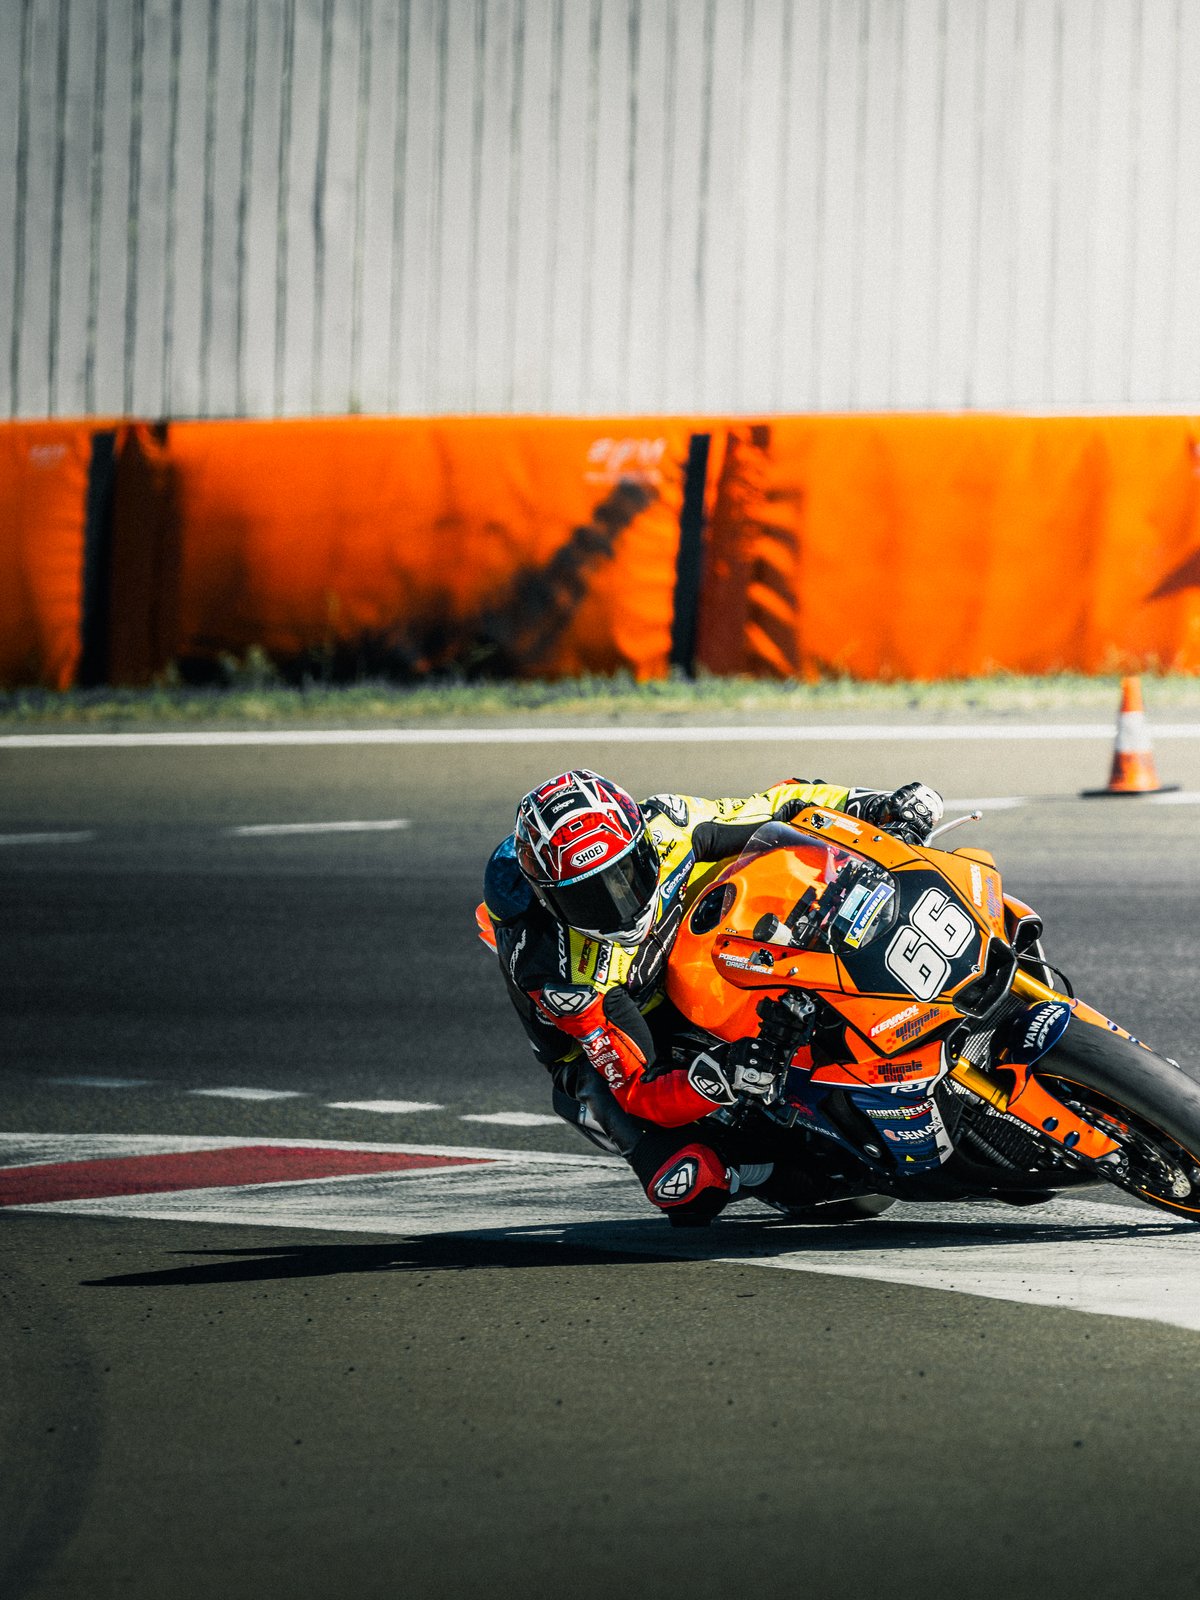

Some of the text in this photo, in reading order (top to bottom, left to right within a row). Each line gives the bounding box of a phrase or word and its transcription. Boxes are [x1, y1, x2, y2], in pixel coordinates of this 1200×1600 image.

[575, 844, 604, 865] SHOEI
[860, 889, 887, 928] MICHELIN
[556, 922, 568, 979] IXON
[599, 941, 613, 972] IPON
[885, 887, 976, 1002] 66
[871, 1004, 920, 1037] KENNOL
[1023, 1002, 1062, 1049] YAMAHA
